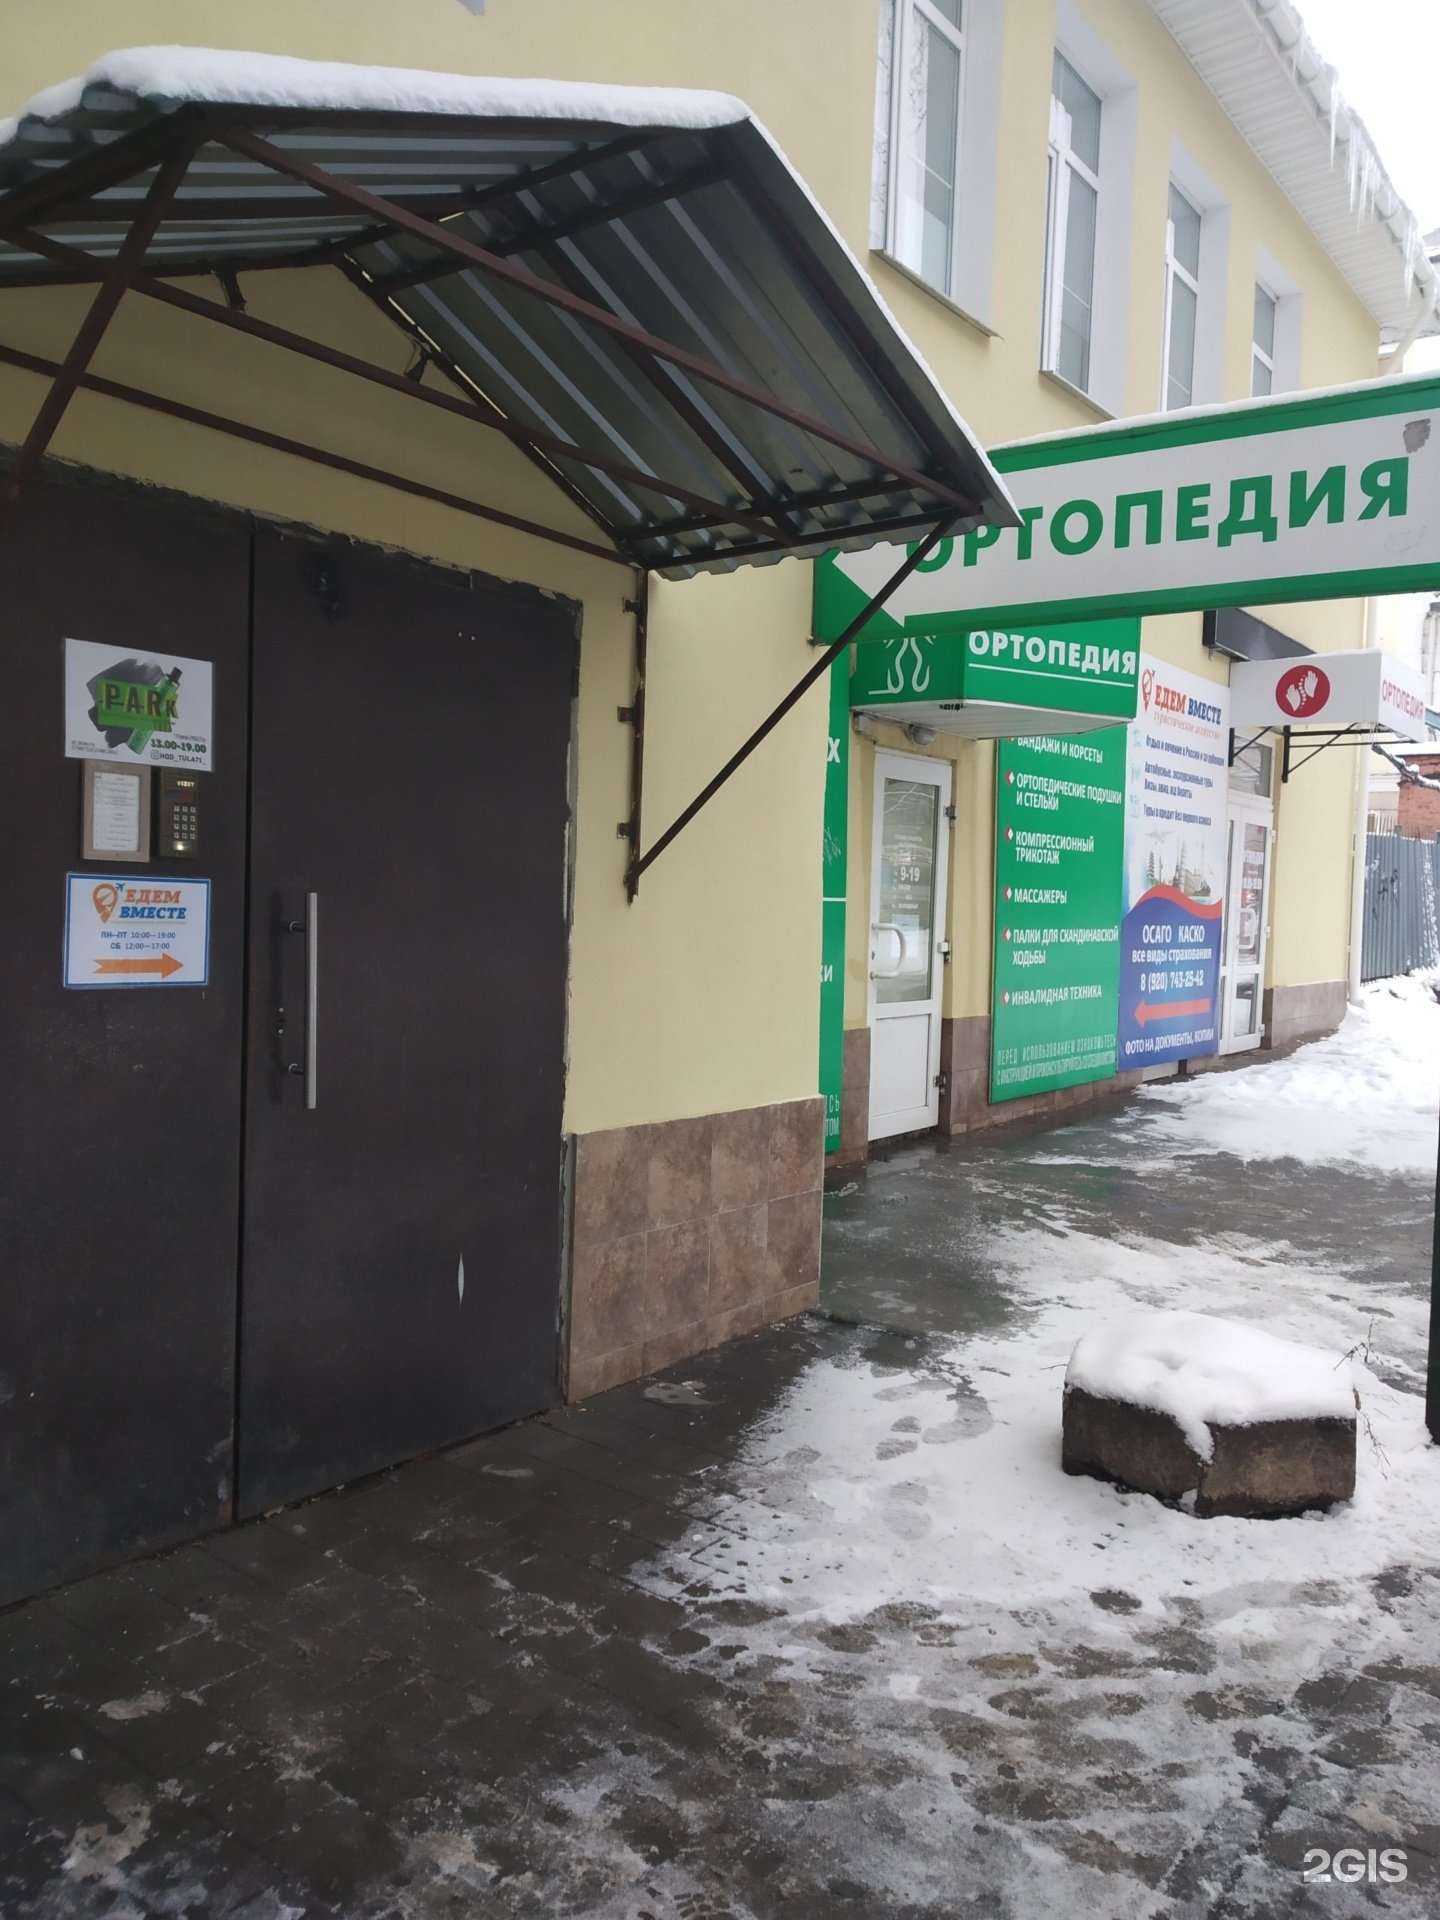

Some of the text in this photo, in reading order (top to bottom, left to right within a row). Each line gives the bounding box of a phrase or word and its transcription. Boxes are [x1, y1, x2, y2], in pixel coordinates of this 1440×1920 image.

[968, 630, 1137, 676] ОРТОПЕДИЯ
[102, 682, 179, 719] PARK
[1154, 685, 1222, 725] ЕДЕМ ВМЕСТЕ
[1382, 679, 1424, 719] ОРТОПЕДИЯ
[1061, 741, 1068, 756] И
[1069, 743, 1104, 763] КОРСЕТЫ
[1016, 772, 1122, 805] ОРТОПЕДИЧЕСКИЕ ПОДУШКИ
[1016, 791, 1059, 811] И СТЕЛЬКИ
[1015, 831, 1095, 852] КОМПРЕССИОННЫЙ
[1015, 847, 1060, 864] ТРИКОТАЖ
[124, 888, 182, 905] ЕДЕМ
[1014, 888, 1067, 904] МАССАЖЕРЫ
[119, 905, 187, 920] ВМЕСТЕ
[1013, 926, 1119, 947] ПАЛКИ ДЛЯ СКАНДИНАВСКОЙ
[1142, 924, 1205, 944] ОСАГО КАСКО
[110, 942, 121, 950] СБ
[1012, 950, 1046, 968] ХОДЬБЫ
[1146, 950, 1167, 966] виды
[1140, 973, 1146, 992] 8
[1011, 985, 1102, 1006] ИНВАЛИДНАЯ ТЕХНИКА
[1125, 1040, 1145, 1055] ФОТО
[1145, 1038, 1154, 1052] НА
